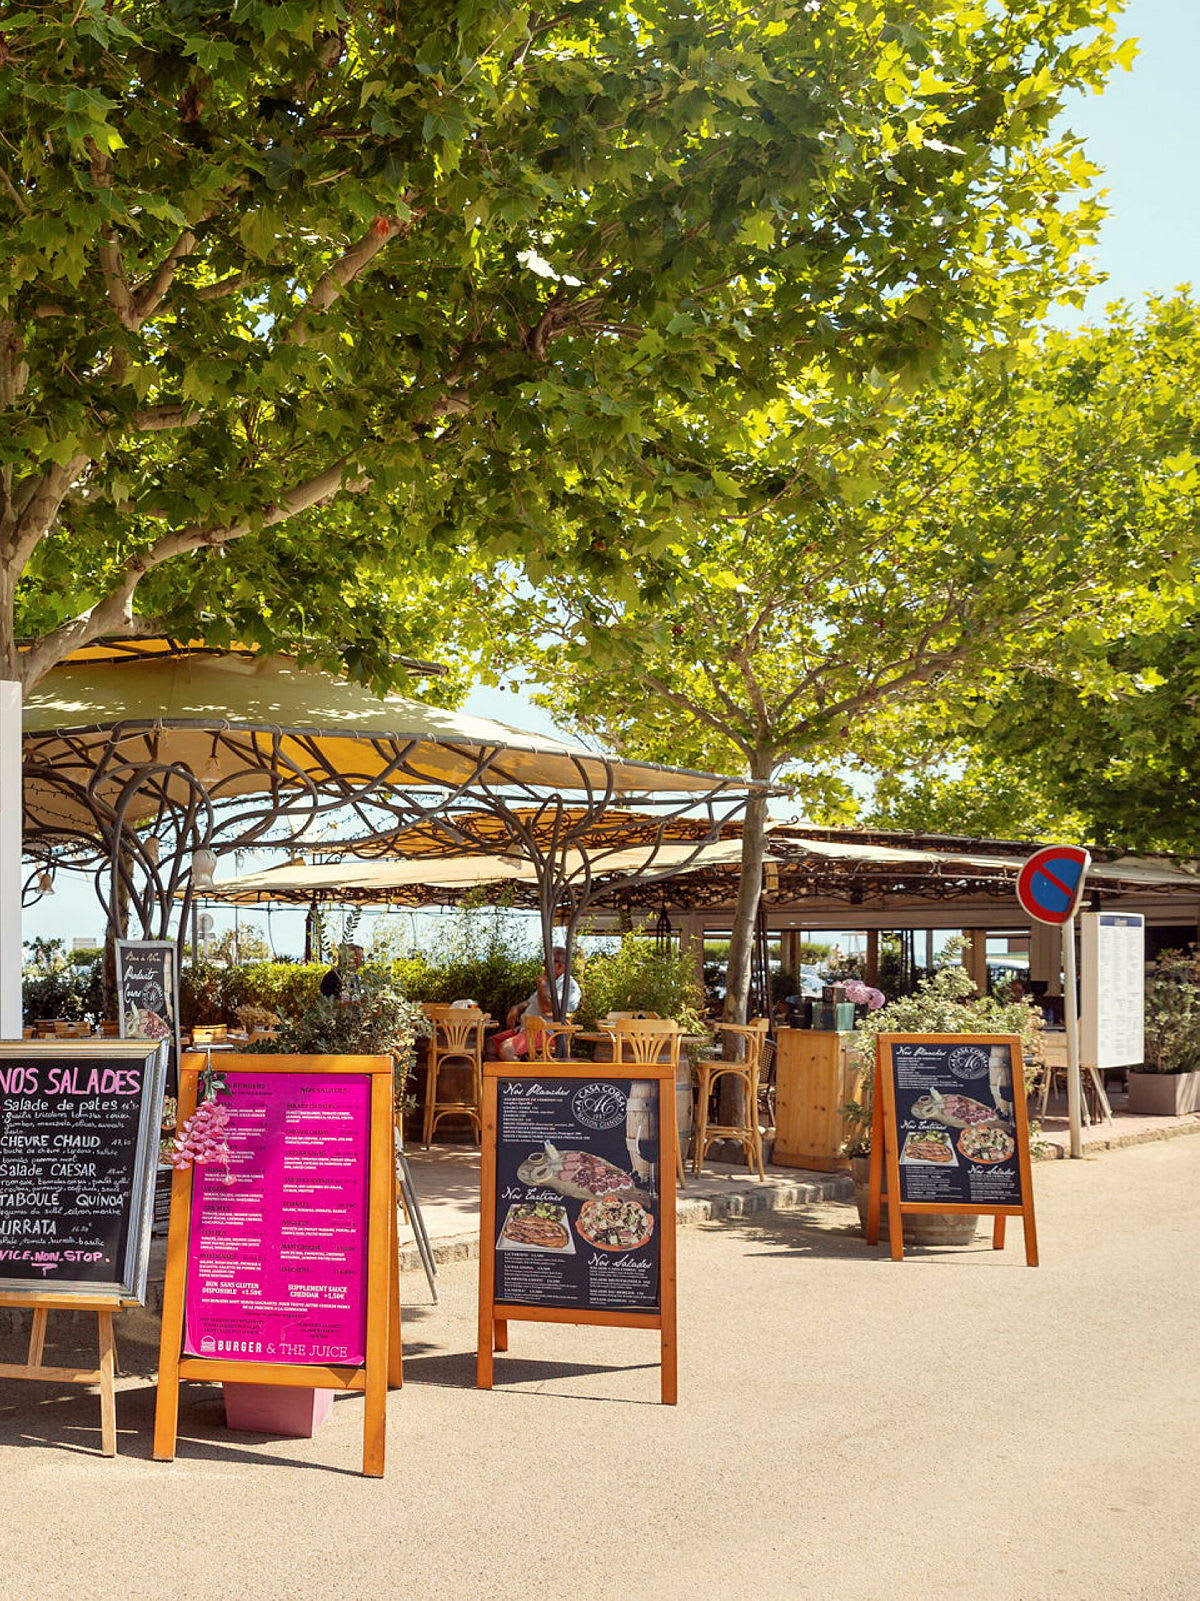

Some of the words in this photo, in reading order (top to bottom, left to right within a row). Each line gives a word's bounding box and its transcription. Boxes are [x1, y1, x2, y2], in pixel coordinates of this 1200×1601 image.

[44, 1067, 142, 1095] SALADES
[502, 1082, 523, 1096] Nos
[526, 1083, 571, 1097] Planches
[578, 1084, 601, 1099] CASA
[602, 1085, 626, 1107] CORSA
[3, 1099, 49, 1111] Salade
[57, 1100, 74, 1111] de
[0, 1135, 50, 1147] CHEVRE
[53, 1135, 101, 1147] CHAUD
[0, 1163, 43, 1176] Salade
[50, 1163, 97, 1177] CAESAR
[502, 1186, 521, 1200] Nos
[587, 1253, 609, 1267] Nos
[611, 1254, 652, 1269] Salades
[288, 1284, 328, 1292] SUPPLEMENT
[328, 1285, 348, 1293] SAUCE
[290, 1291, 319, 1299] CHEDDAR
[217, 1340, 262, 1353] BURGER
[266, 1343, 276, 1354] &
[279, 1343, 306, 1356] THE
[308, 1345, 348, 1358] JUICE
